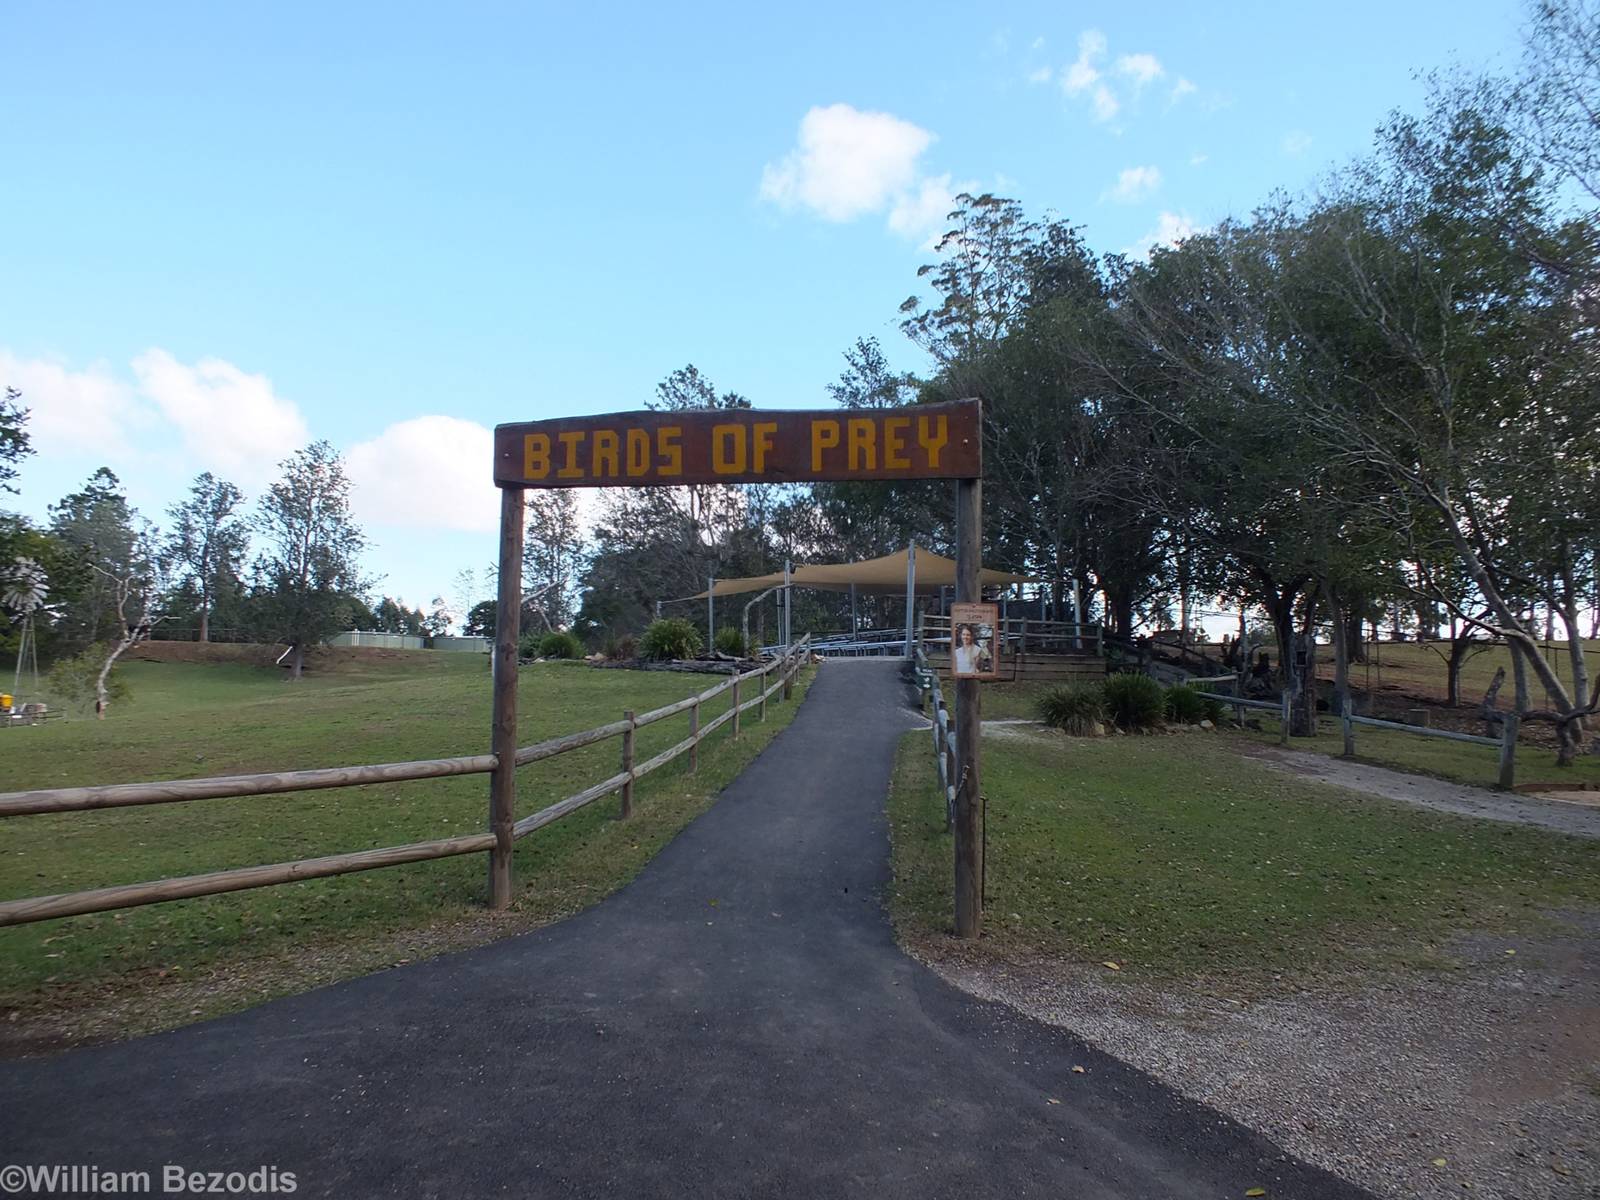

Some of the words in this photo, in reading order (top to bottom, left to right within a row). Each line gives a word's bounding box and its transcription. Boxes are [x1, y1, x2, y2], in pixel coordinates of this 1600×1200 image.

[523, 427, 682, 480] BIRDS
[712, 422, 778, 474] OF
[811, 415, 948, 472] PREY
